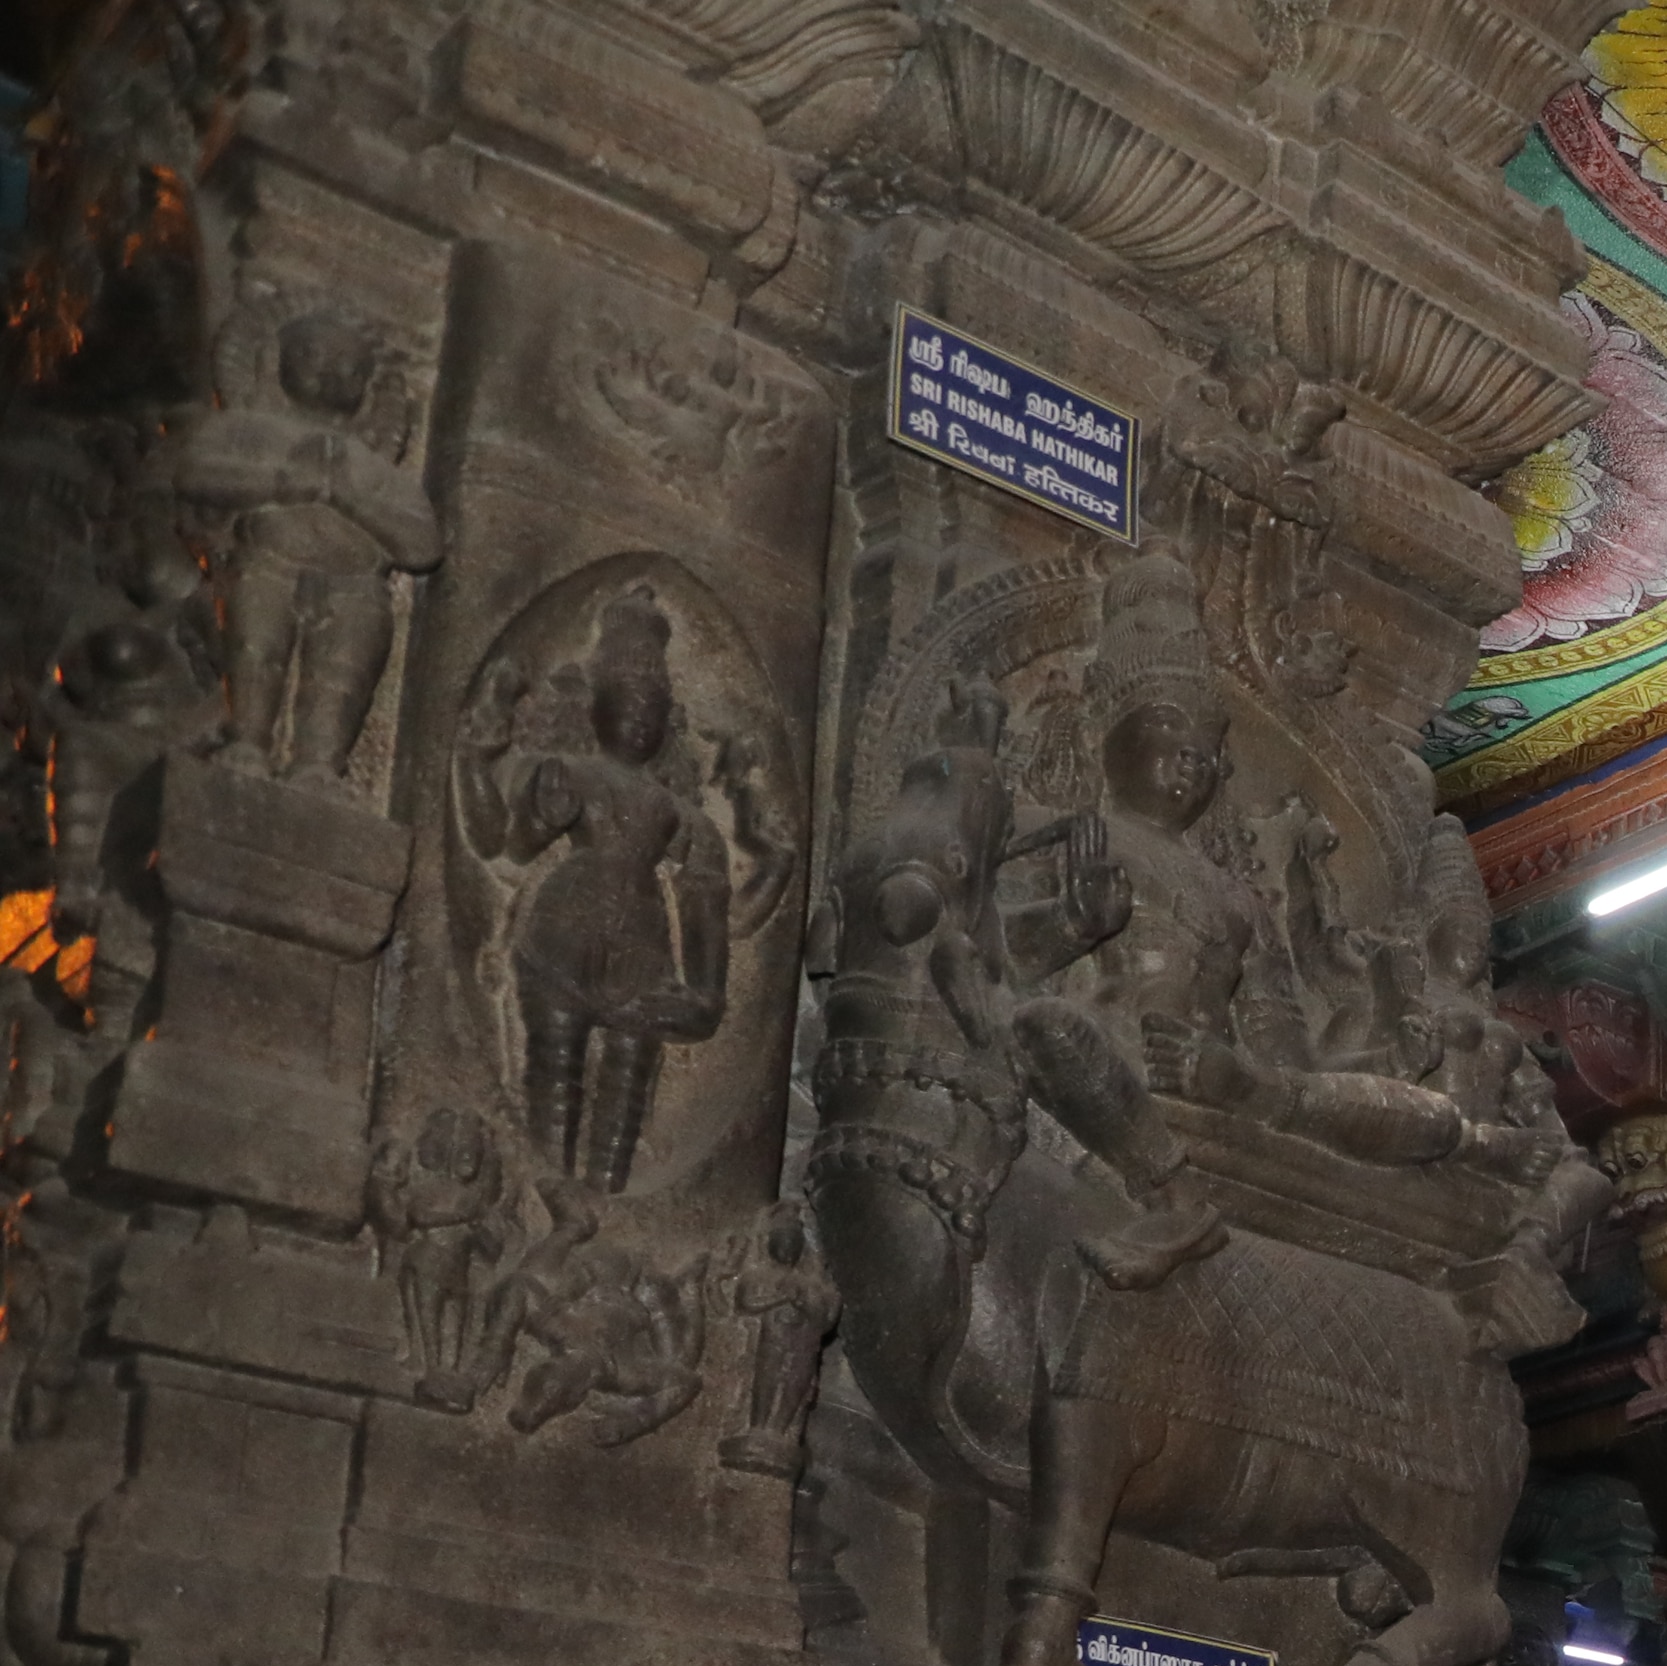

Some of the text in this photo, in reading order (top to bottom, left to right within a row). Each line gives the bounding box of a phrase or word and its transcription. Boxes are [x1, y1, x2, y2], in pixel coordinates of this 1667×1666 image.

[908, 408, 940, 441] श्री
[910, 373, 1119, 486] SRI RISHABA HATHIKAR
